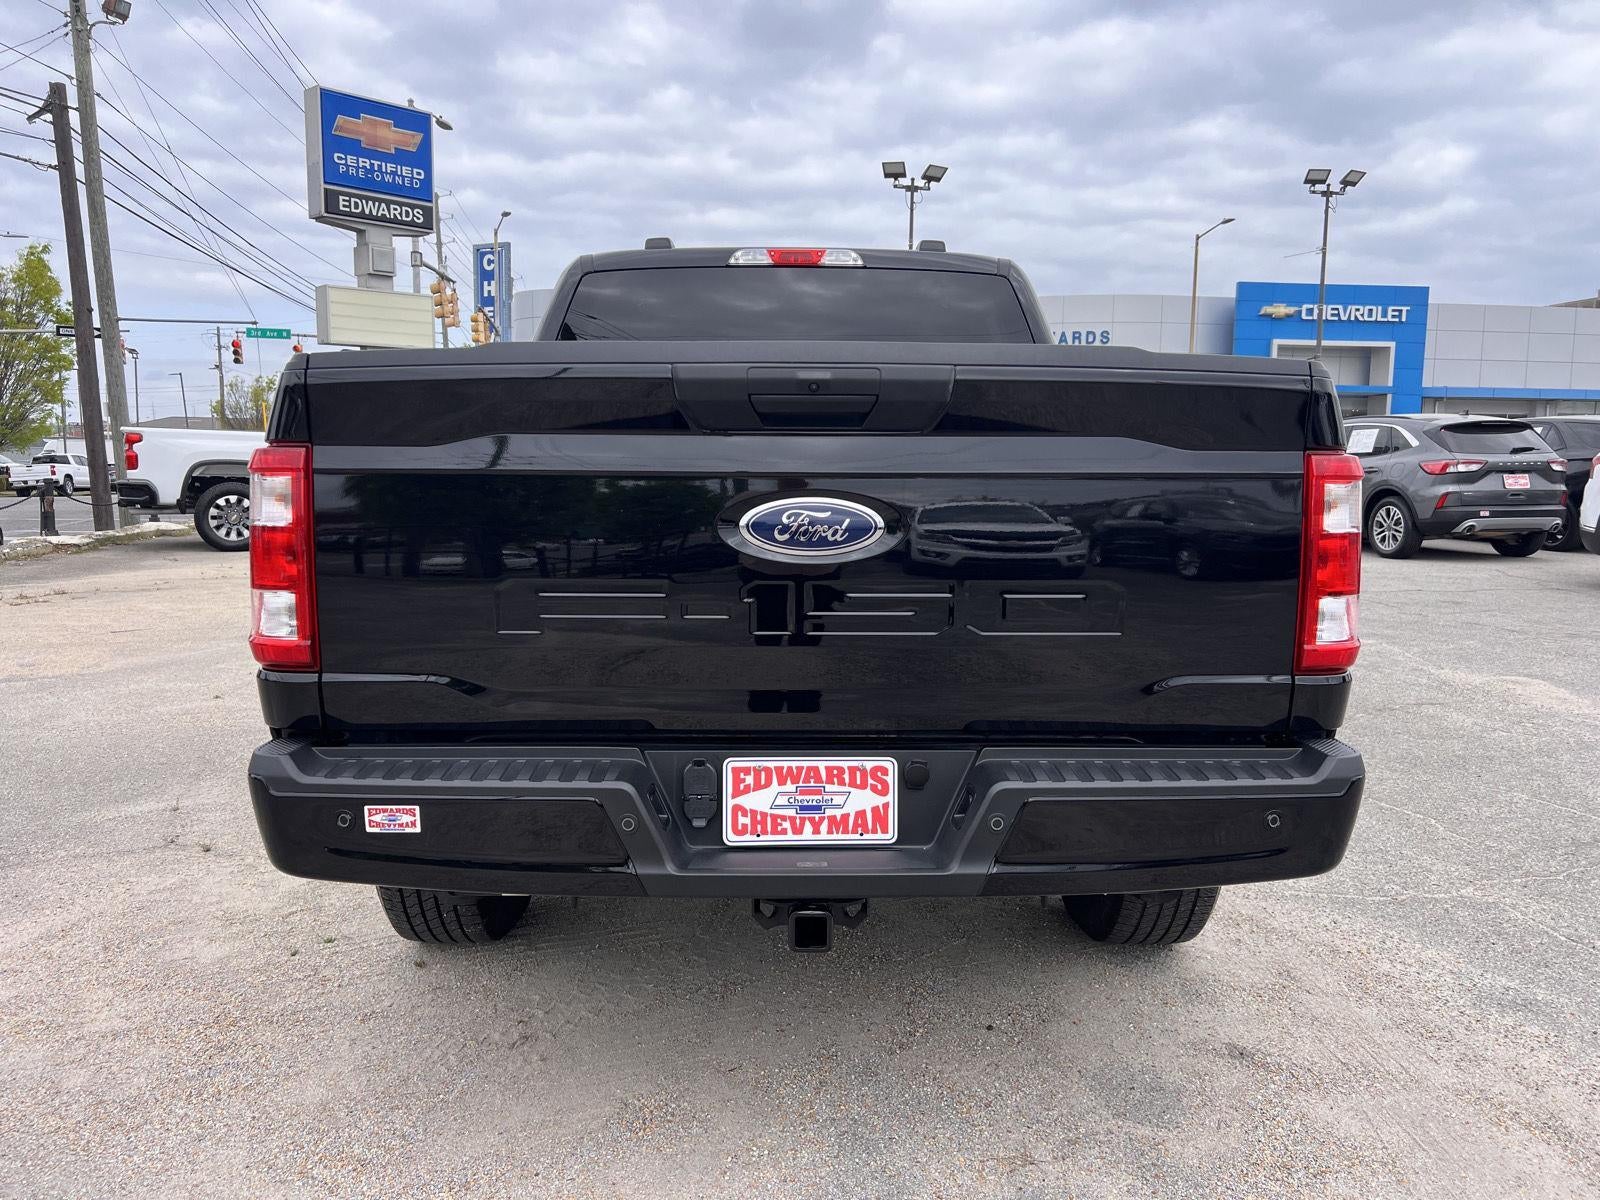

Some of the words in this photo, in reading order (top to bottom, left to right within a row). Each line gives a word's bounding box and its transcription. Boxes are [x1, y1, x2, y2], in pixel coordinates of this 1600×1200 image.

[333, 153, 425, 179] CERTIFIED
[339, 165, 420, 188] PRE-OWNED
[338, 195, 424, 223] EDWARDS
[482, 254, 496, 342] CHE
[1301, 304, 1410, 322] CHEVROLET
[1053, 330, 1110, 345] ARDS
[774, 509, 850, 542] Ford
[495, 579, 1127, 637] F-150
[731, 765, 890, 800] EDWARDS
[367, 808, 416, 818] EDWARDS
[787, 796, 834, 805] Chevrolet
[368, 819, 417, 828] CHEVYMAN
[731, 801, 890, 837] CHEVYMAN
